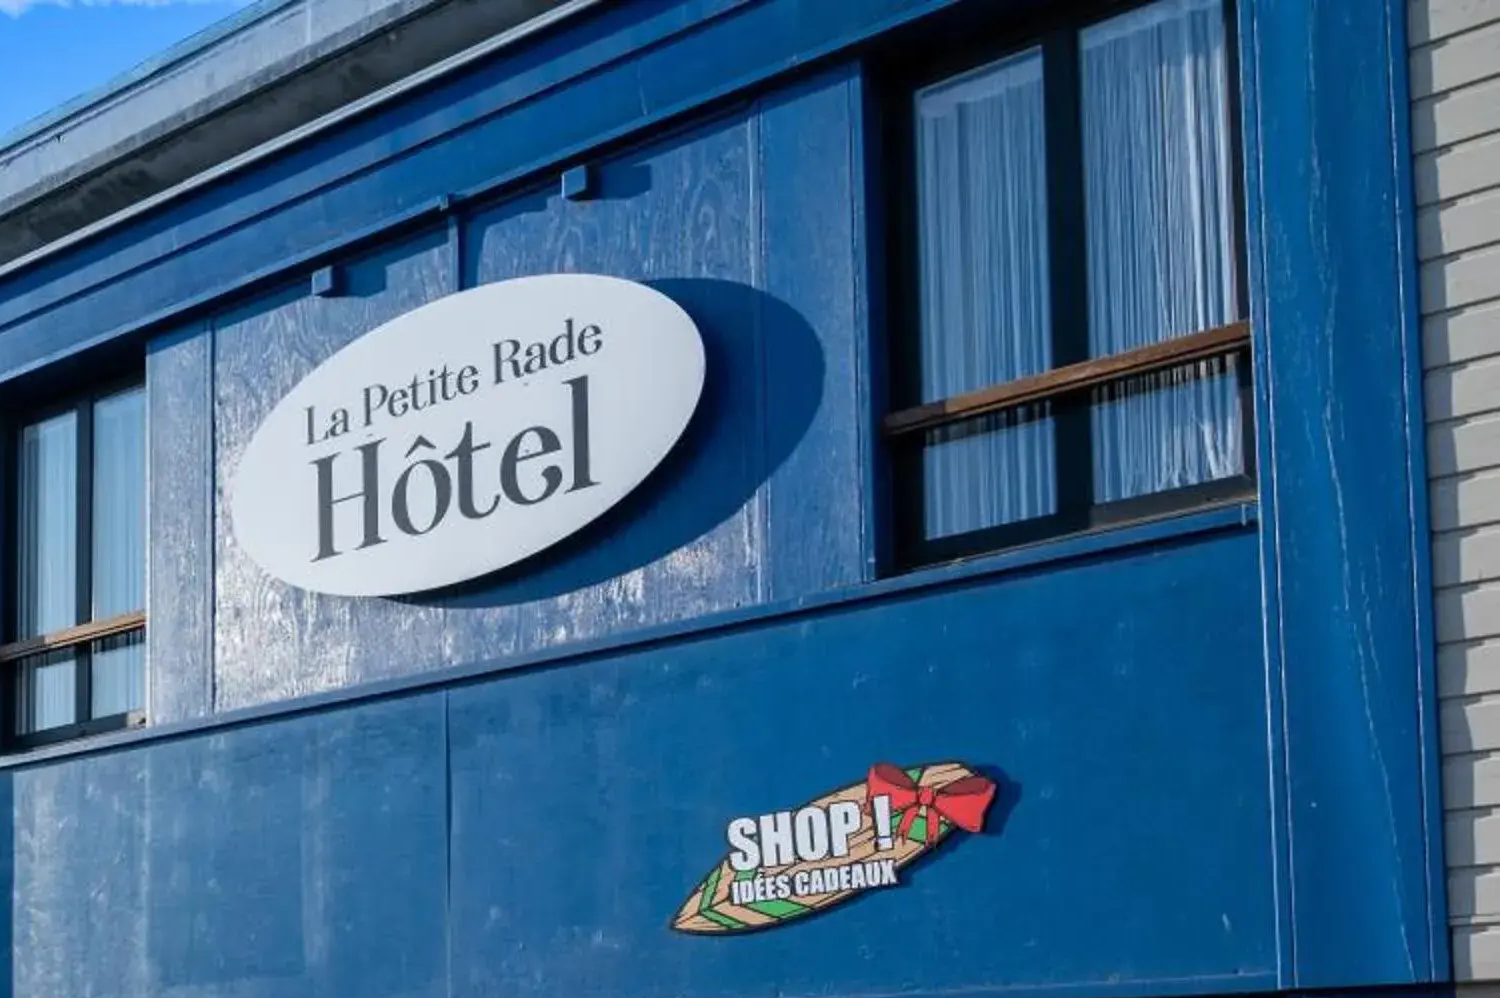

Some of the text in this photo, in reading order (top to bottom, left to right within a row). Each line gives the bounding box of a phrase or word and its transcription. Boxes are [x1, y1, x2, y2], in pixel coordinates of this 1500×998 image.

[306, 317, 603, 445] La Petite Rade
[309, 374, 602, 563] Hôtel
[727, 800, 861, 871] SHOP
[795, 859, 897, 896] CADEAUX
